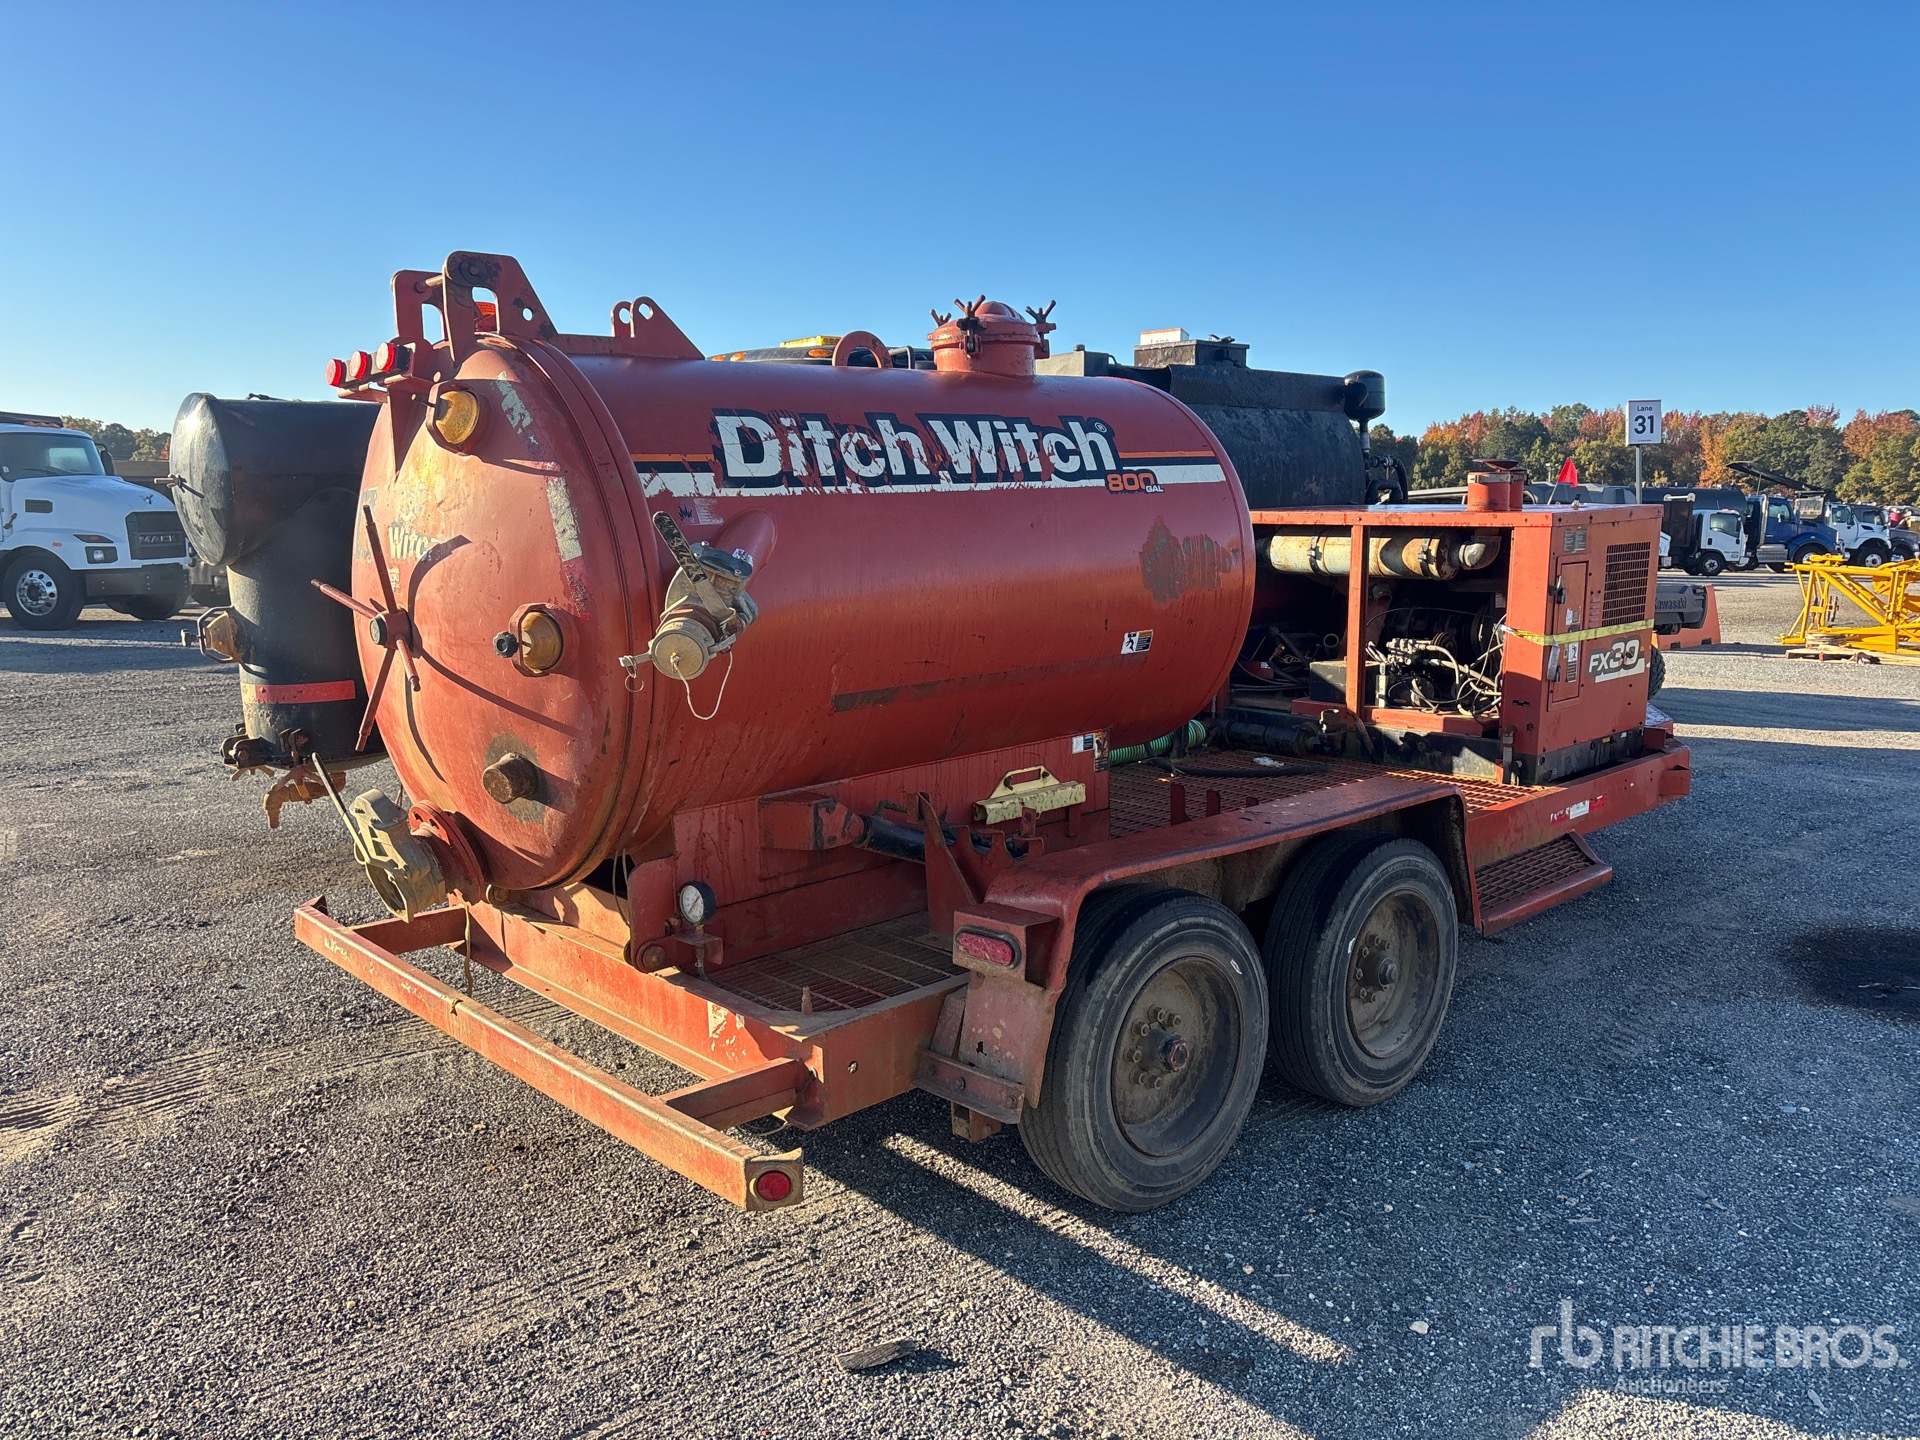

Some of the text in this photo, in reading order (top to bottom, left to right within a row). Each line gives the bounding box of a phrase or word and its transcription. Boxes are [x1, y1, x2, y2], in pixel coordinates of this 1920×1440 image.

[1634, 415, 1654, 434] 31
[715, 416, 930, 478] Ditch
[1106, 473, 1164, 493] 800 GAL
[1589, 640, 1640, 673] FX30
